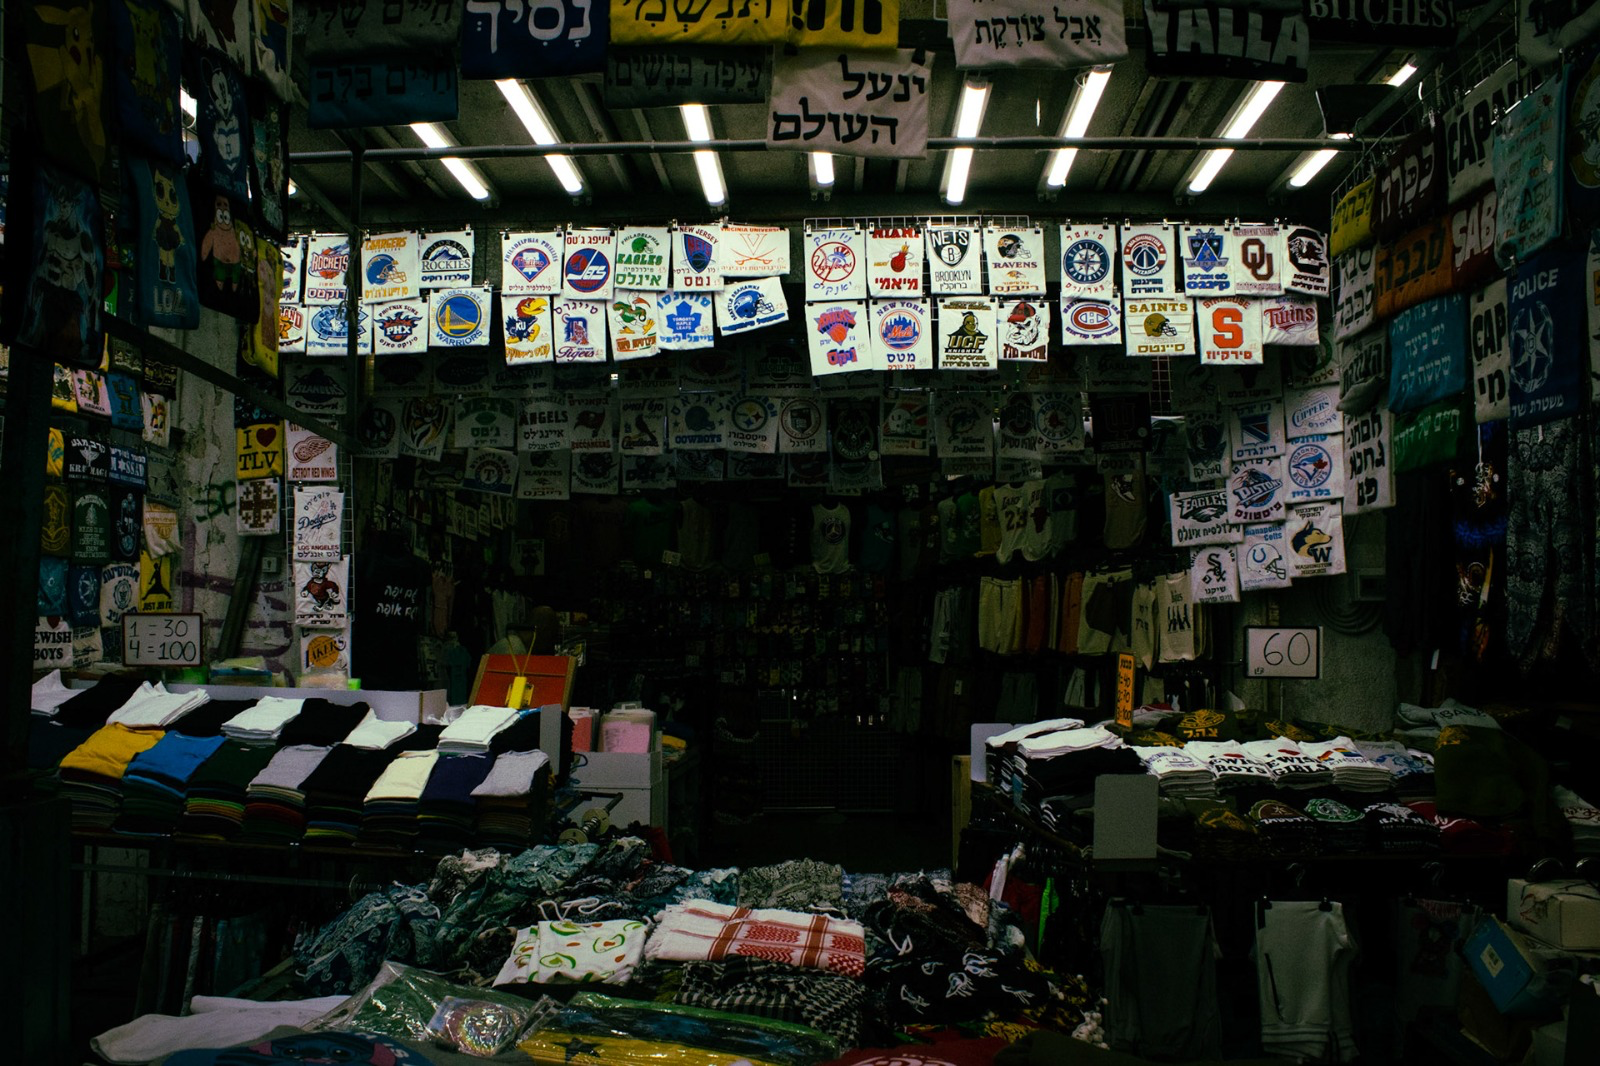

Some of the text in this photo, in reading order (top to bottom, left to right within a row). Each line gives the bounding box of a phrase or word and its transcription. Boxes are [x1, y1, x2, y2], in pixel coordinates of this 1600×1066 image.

[1145, 8, 1310, 69] YALLA
[772, 97, 898, 145] העולם
[621, 232, 660, 247] PHILADELPHIA
[695, 228, 719, 245] JERSEY
[931, 231, 969, 248] NETS
[1128, 234, 1161, 248] WASHINGTON
[365, 237, 408, 251] CHARGERS
[504, 237, 539, 263] PHILADELPHIA
[688, 237, 711, 256] NETS
[616, 253, 663, 265] EAGLES
[948, 248, 955, 262] B
[1242, 239, 1274, 281] OU
[311, 253, 349, 272] ROCKETS
[422, 259, 472, 271] ROCKIES
[992, 261, 1038, 269] RAVENS
[935, 270, 972, 282] BROOKLYN
[1132, 266, 1160, 276] WIZARDS
[616, 272, 662, 286] איגלס
[684, 276, 711, 287] נטס
[875, 277, 919, 290] מיאמי
[1511, 267, 1559, 304] POLICE
[939, 282, 968, 292] ברוקלין
[436, 289, 484, 305] GOLDEN STATE
[1203, 297, 1251, 309] SYRACUSE
[379, 304, 419, 317] PHOENIX SUNS
[876, 301, 897, 316] NEW
[900, 301, 926, 316] YORK
[1129, 303, 1188, 313] SAINTS
[1264, 306, 1315, 330] Twins
[386, 325, 411, 336] PHX
[516, 322, 526, 331] KU
[889, 324, 913, 338] Mets
[1212, 308, 1243, 349] S
[436, 329, 483, 347] WARRIORS
[948, 335, 988, 348] UCF
[556, 346, 595, 361] Tigers
[1138, 343, 1185, 353] סיינטס
[886, 352, 916, 363] מטס
[519, 410, 568, 425] ANGELS
[1292, 401, 1329, 427] CLIPPERS
[243, 430, 252, 450] I
[675, 434, 722, 444] COWBOYS
[961, 436, 985, 444] Miami
[952, 445, 986, 454] Dolphins
[1292, 447, 1318, 463] TORONTO
[239, 451, 279, 471] TLV
[292, 467, 335, 478] DETROIT RED WINGS
[1293, 470, 1328, 486] BLUE JAYS
[1235, 501, 1283, 520] פיסטונס
[298, 512, 337, 531] Dodgers
[1264, 532, 1283, 541] Colts
[1313, 547, 1332, 562] W
[129, 618, 188, 638] 1 30
[33, 631, 72, 643] EWISH
[129, 640, 196, 662] 4 100
[1263, 632, 1311, 667] 60
[1217, 763, 1267, 775] BOYS
[1275, 764, 1329, 776] GIRLS
